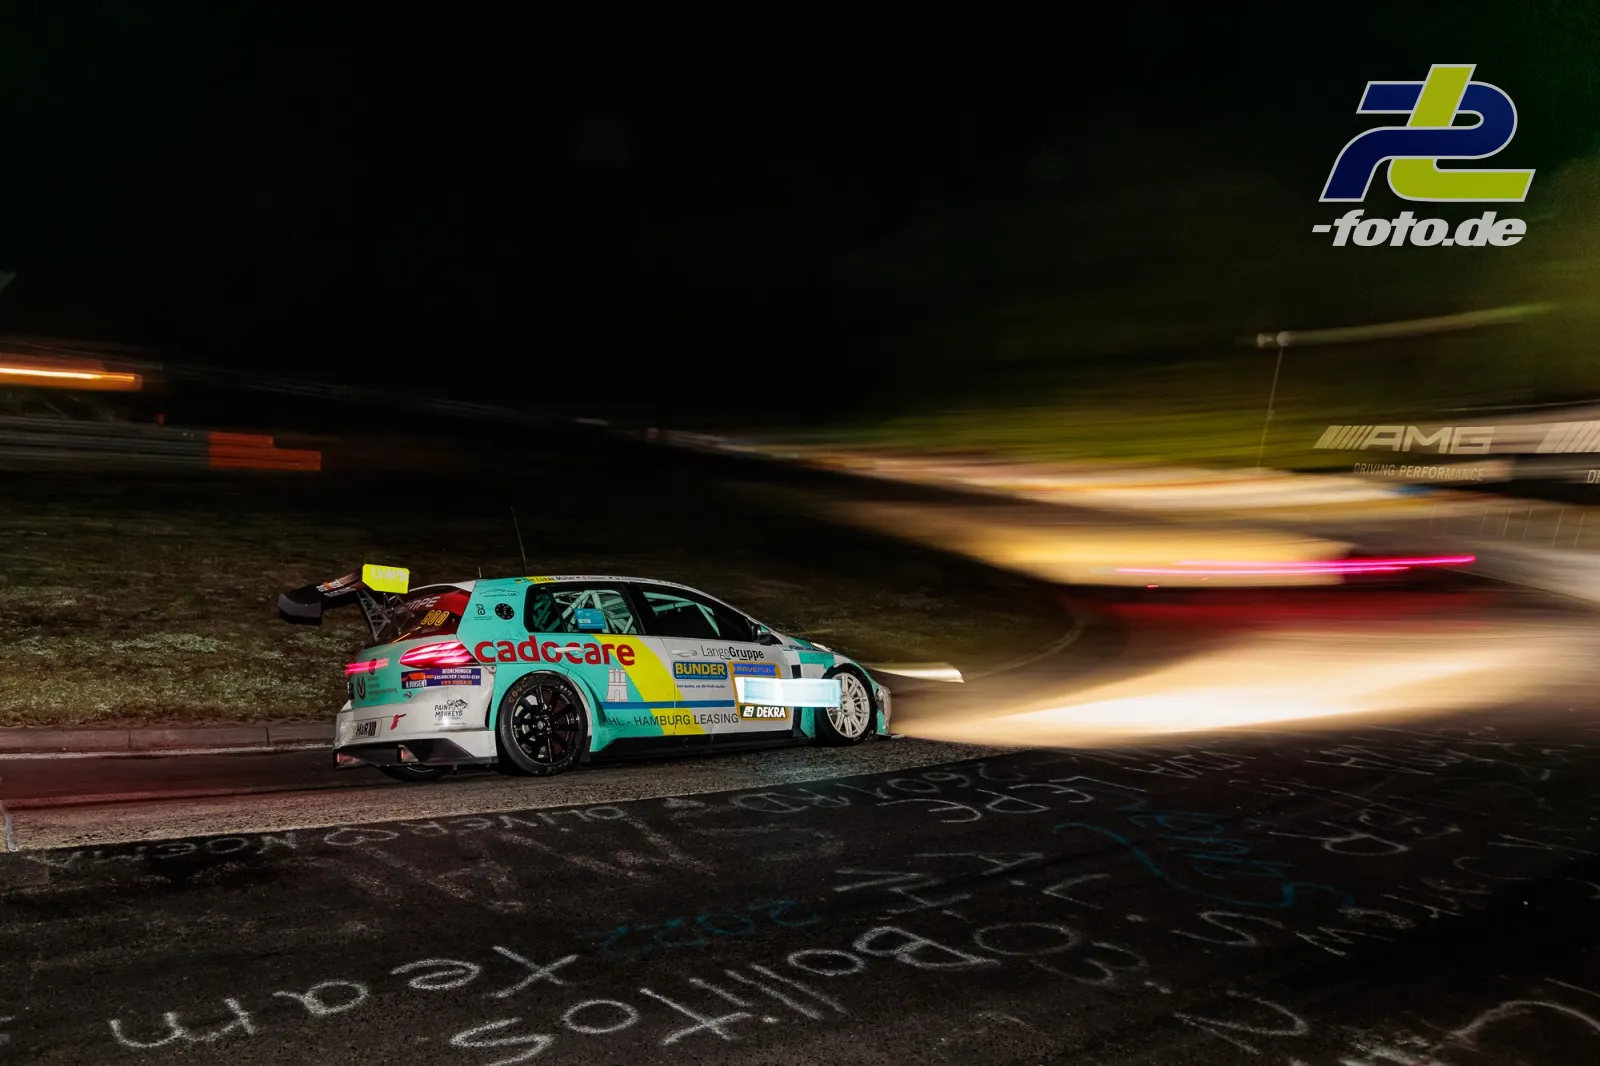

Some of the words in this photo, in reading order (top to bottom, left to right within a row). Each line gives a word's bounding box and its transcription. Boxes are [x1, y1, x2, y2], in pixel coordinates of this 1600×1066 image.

[1361, 425, 1494, 454] AMG
[1354, 462, 1395, 476] DRIVING
[1400, 465, 1484, 481] PERFORMANCE
[474, 635, 635, 666] cadocare
[701, 645, 765, 661] LangeGruppe
[675, 664, 726, 675] BÜNDER
[634, 714, 691, 726] HAMBURG
[694, 713, 739, 724] LEASING
[757, 706, 786, 718] DEKRA
